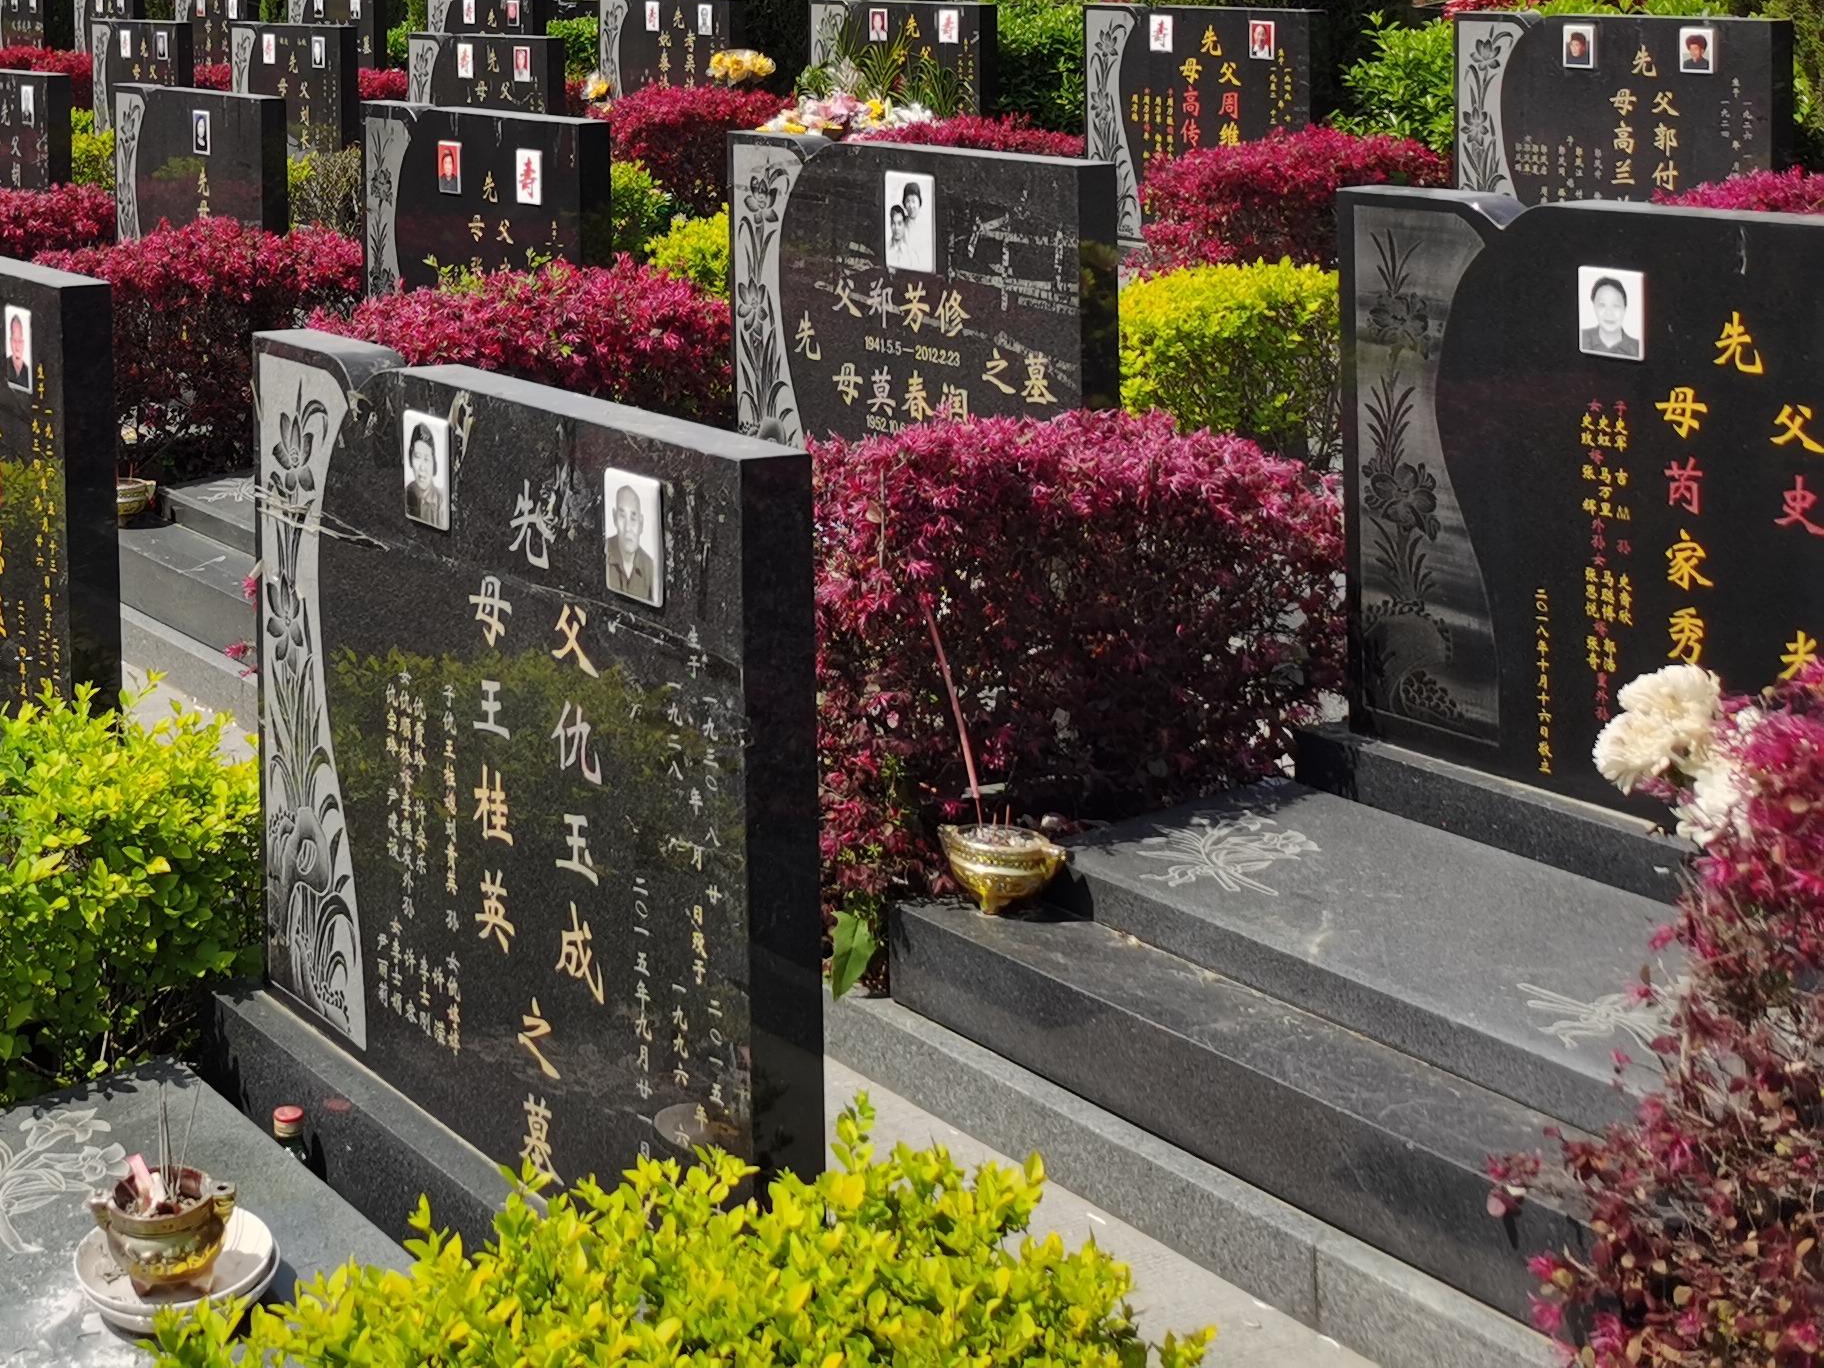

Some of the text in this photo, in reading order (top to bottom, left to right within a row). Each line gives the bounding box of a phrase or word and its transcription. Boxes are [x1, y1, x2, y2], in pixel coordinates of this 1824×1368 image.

[673, 6, 685, 29] 先
[906, 13, 920, 38] 先
[1200, 24, 1223, 56] 先
[1631, 44, 1657, 78] 先
[482, 170, 498, 203] 先
[794, 310, 821, 361] 先
[832, 277, 971, 338] 父郑芳修
[1713, 311, 1763, 374] 先
[981, 348, 1058, 405] 之墓
[509, 481, 555, 569] 先
[1655, 387, 1714, 664] 母芮家秀
[469, 575, 515, 953] 母王桂英
[553, 602, 604, 1005] 父仇玉成
[516, 998, 562, 1184] 之墓
